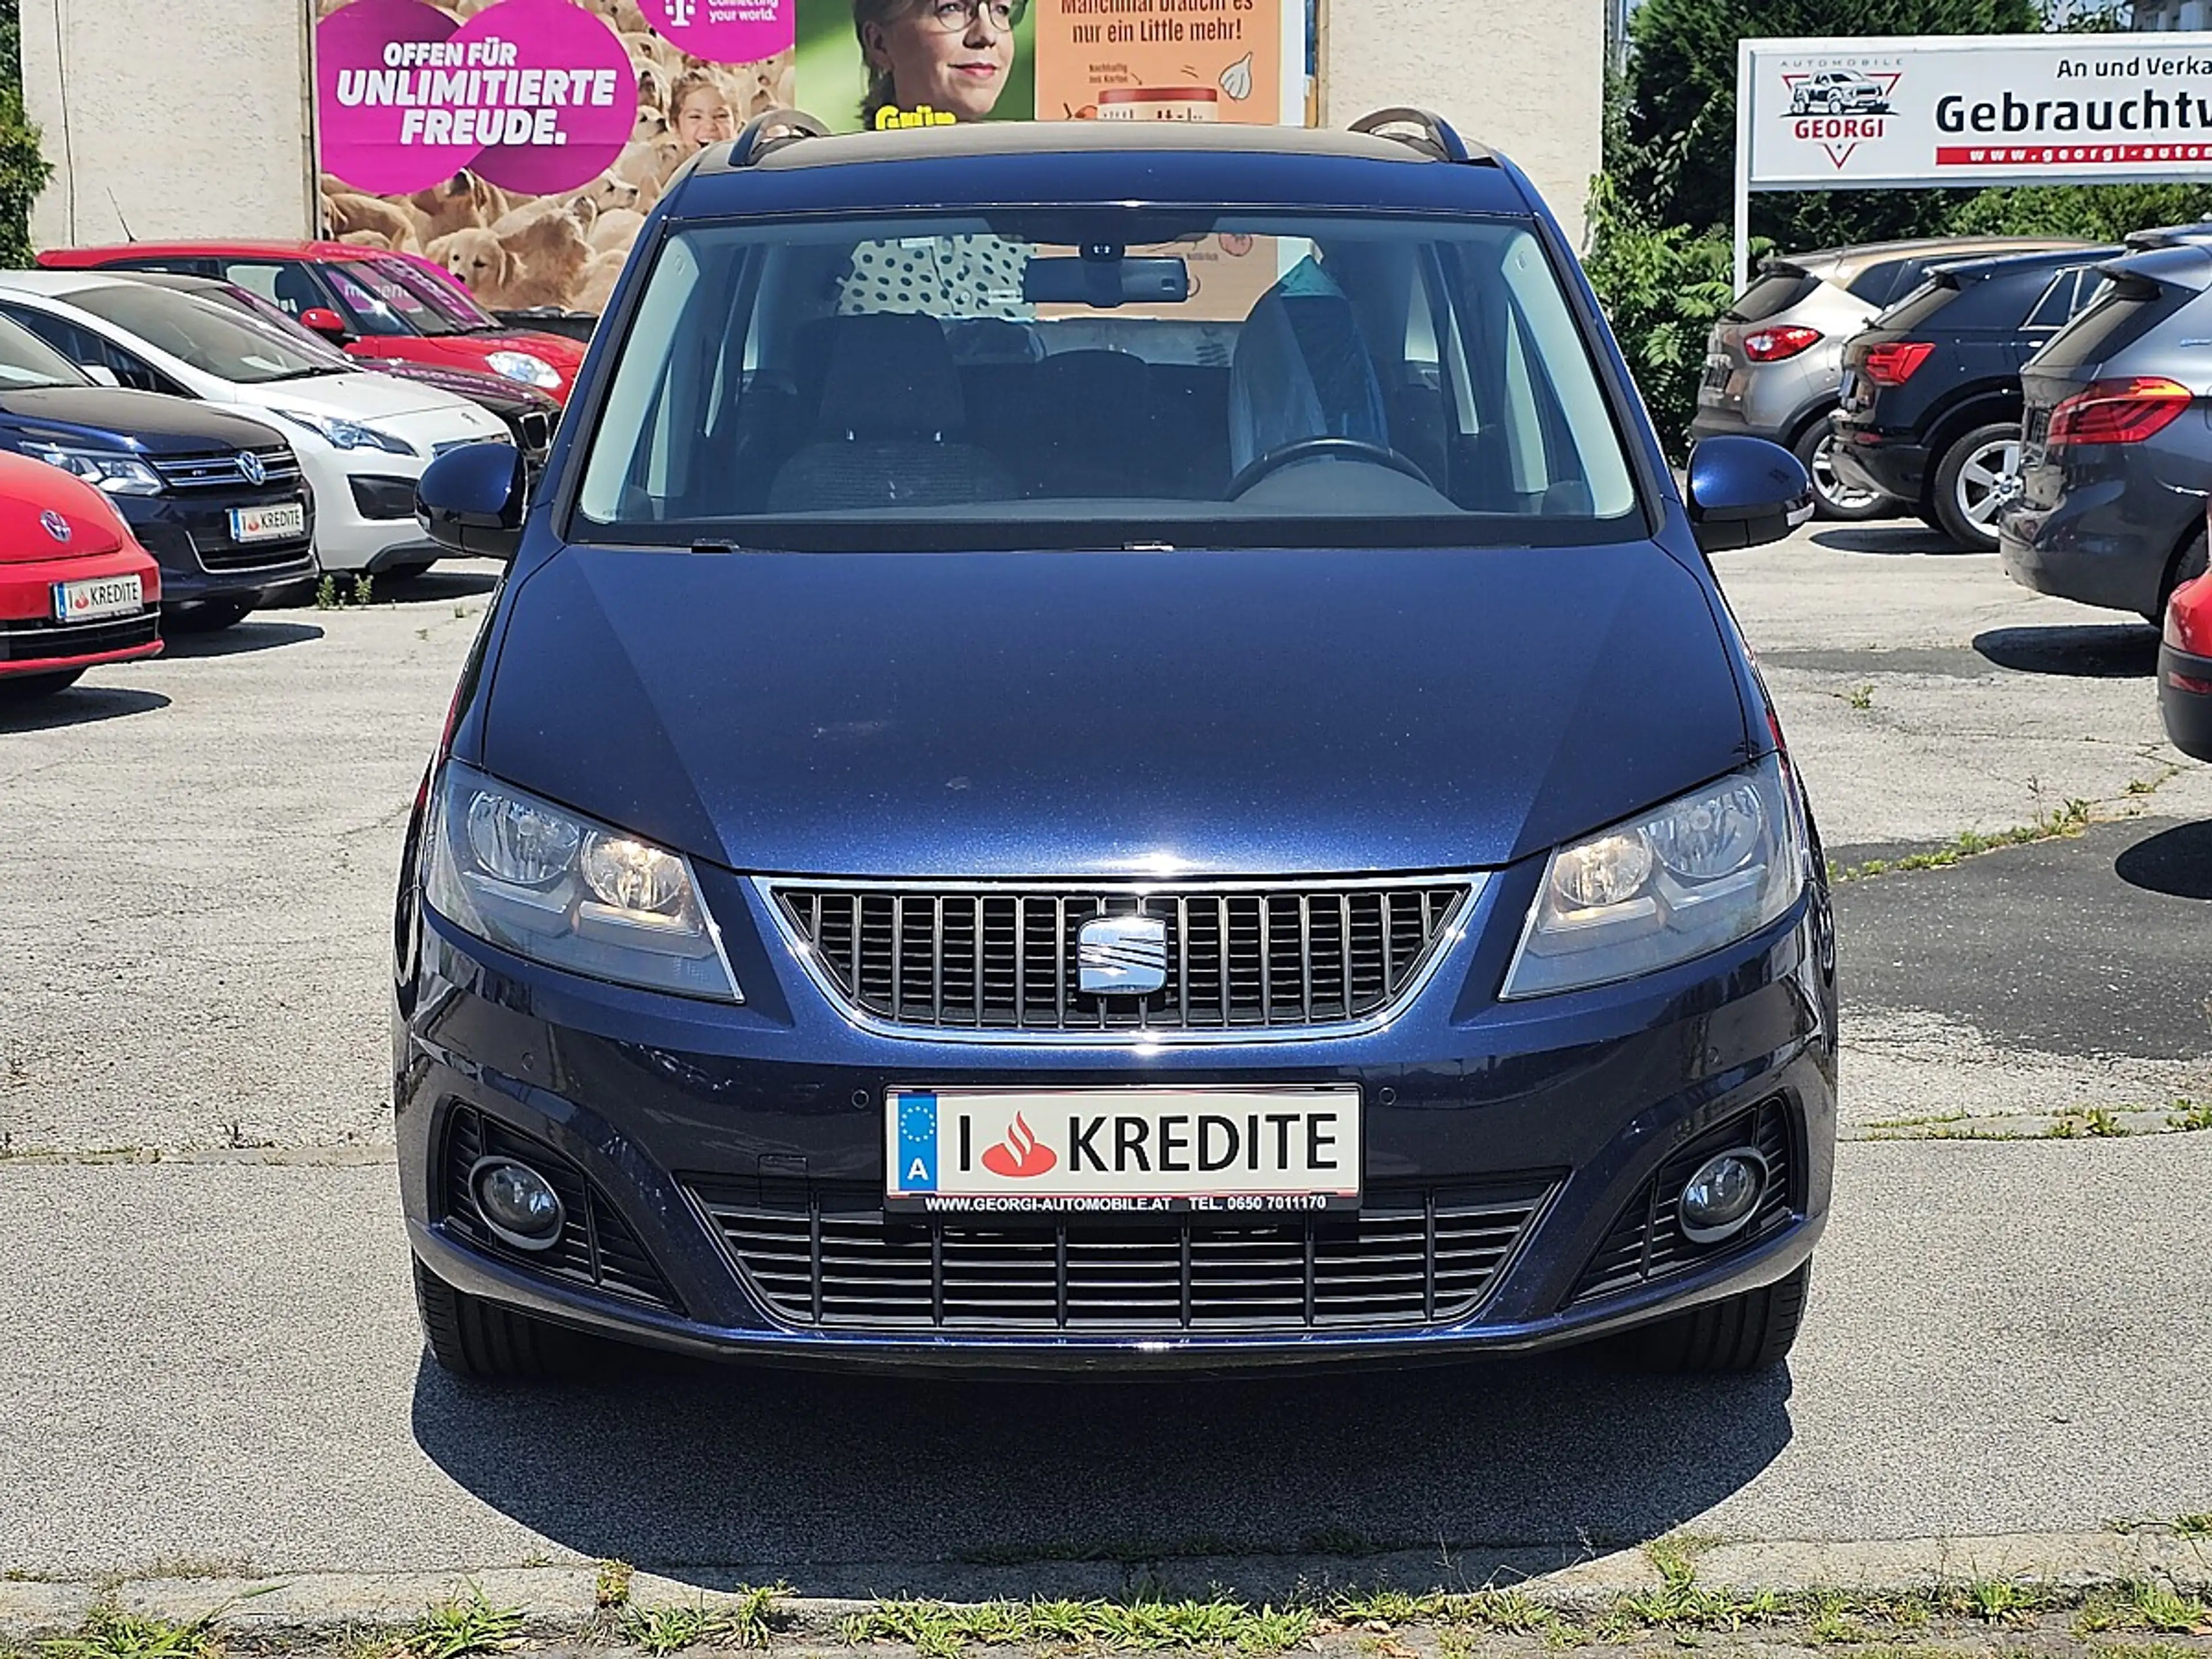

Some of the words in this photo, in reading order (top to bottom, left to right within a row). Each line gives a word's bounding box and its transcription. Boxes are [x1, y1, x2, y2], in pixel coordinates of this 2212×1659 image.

[709, 10, 736, 24] your
[739, 8, 777, 21] world.
[1072, 26, 1101, 43] nur
[1107, 22, 1134, 41] ein
[1141, 18, 1184, 41] Little
[1190, 18, 1242, 40] mehr!
[384, 42, 464, 67] OFFEN
[468, 37, 517, 66] FÜR
[1781, 59, 1903, 67] AUTOMOBILE
[2057, 59, 2088, 78] An
[2096, 57, 2139, 76] und
[336, 70, 617, 106] UNLIMITIERTE
[400, 109, 567, 145] FREUDE.
[1794, 119, 1883, 139] GEORGI
[260, 509, 300, 529] KREDITE
[90, 582, 138, 606] KREDITE
[960, 1115, 971, 1171] I
[1069, 1113, 1338, 1172] KREDITE
[907, 1157, 929, 1181] A
[925, 1197, 1172, 1211] WWW.GEORGI-AUTOMOBILE.AT
[1189, 1196, 1223, 1210] TEL.
[1228, 1196, 1262, 1210] 0650
[1267, 1195, 1327, 1209] 7011170
